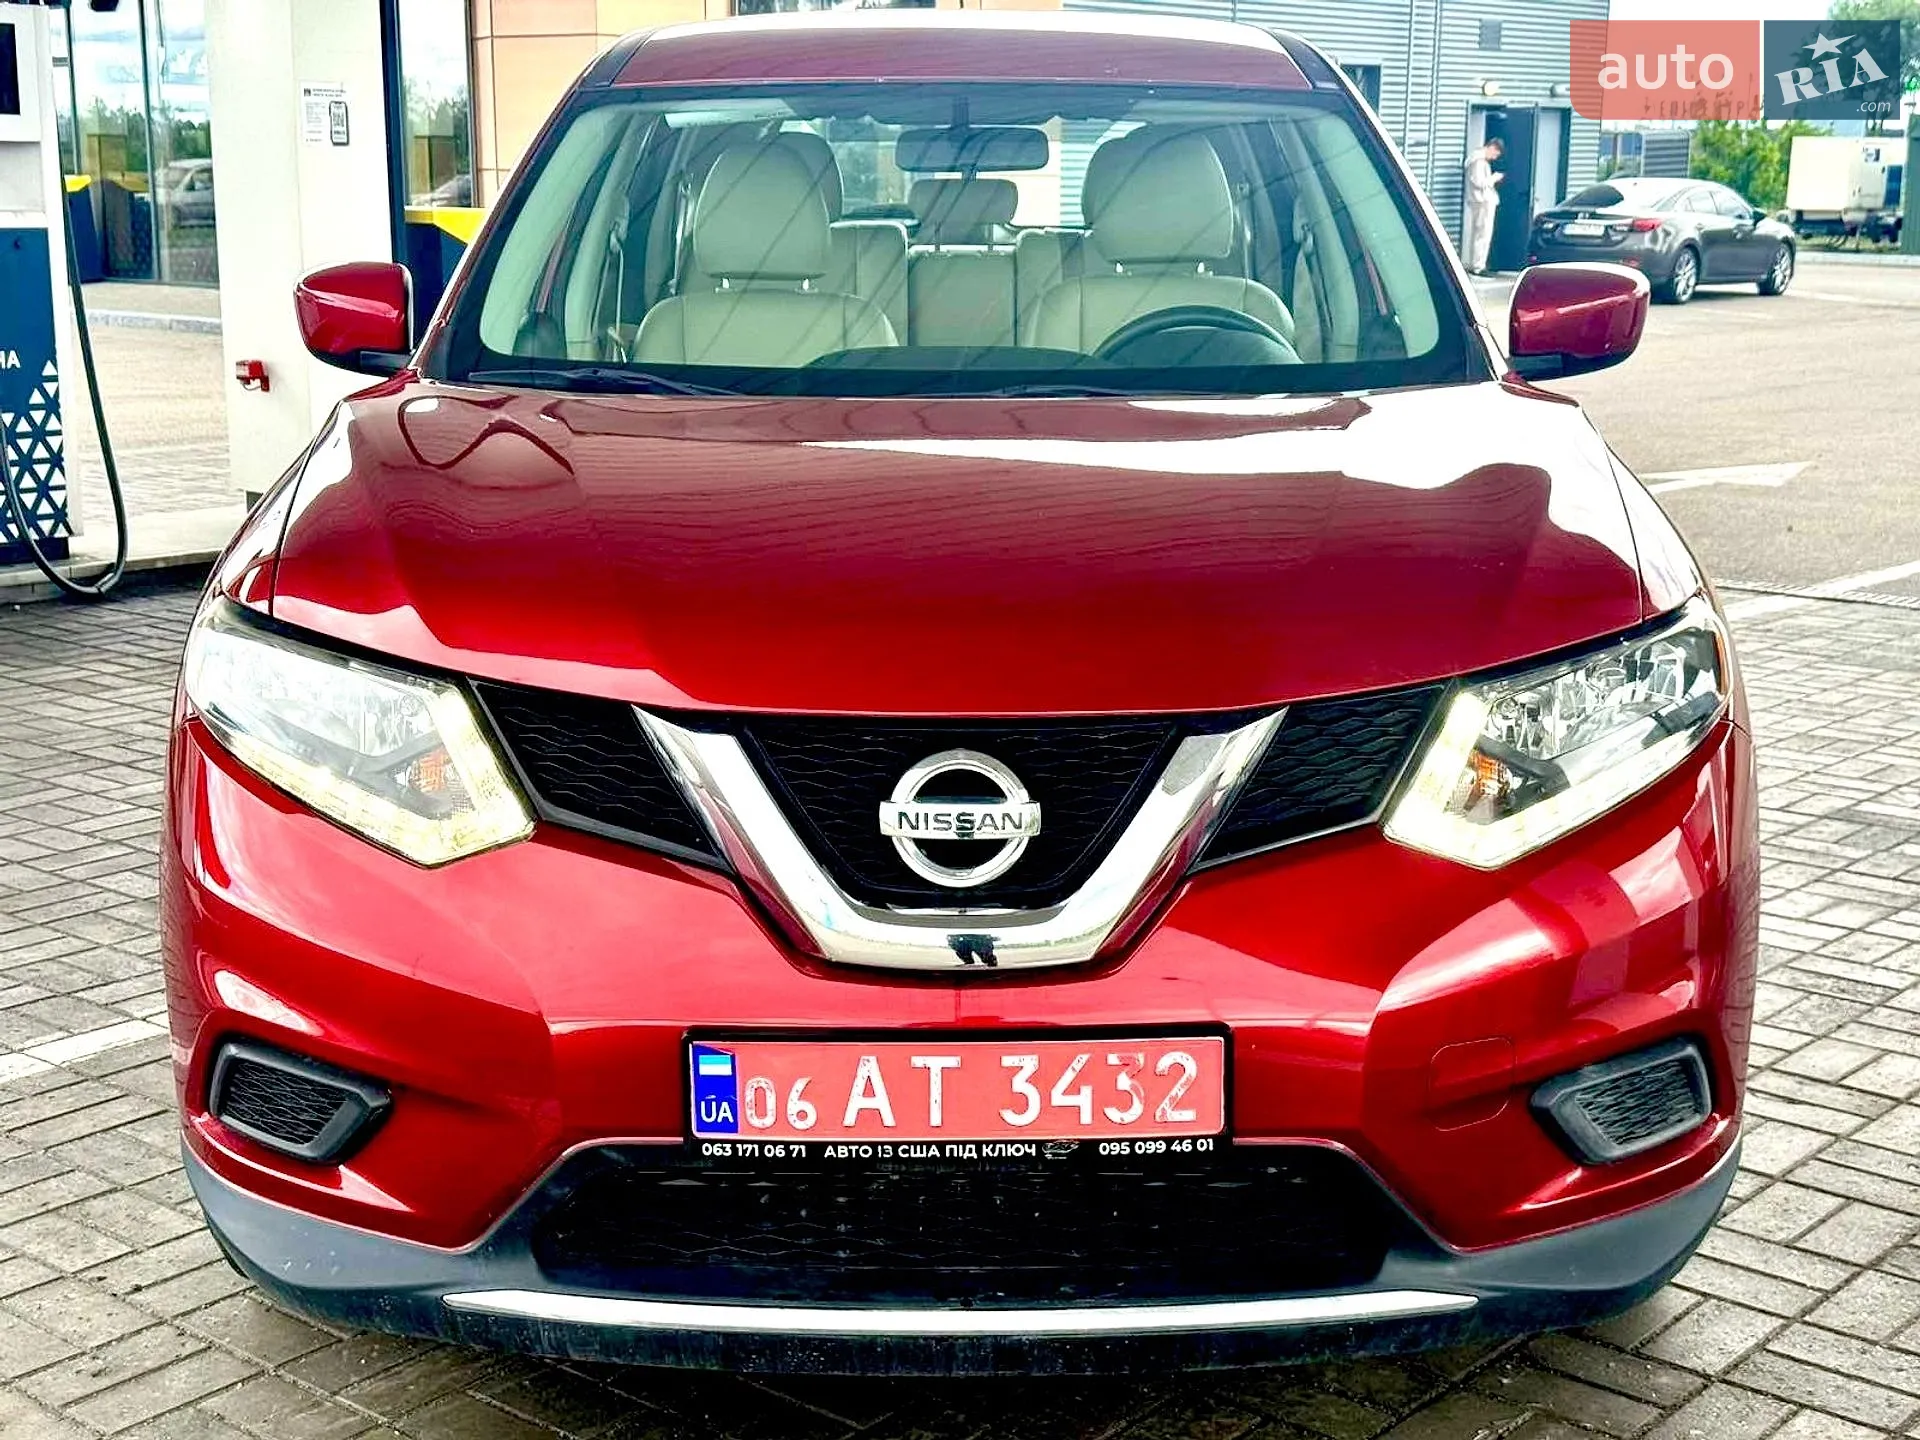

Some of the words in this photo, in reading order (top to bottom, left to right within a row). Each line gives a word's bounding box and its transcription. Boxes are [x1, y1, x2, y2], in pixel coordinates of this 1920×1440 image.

[897, 811, 1023, 832] NISSAN
[743, 1075, 818, 1130] 06
[998, 1051, 1198, 1127] 3432
[700, 1101, 734, 1123] UA
[701, 1142, 733, 1157] 063
[735, 1143, 759, 1158] 171
[763, 1144, 786, 1158] 06
[789, 1144, 806, 1158] 71
[823, 1144, 873, 1159] АВТО
[897, 1144, 941, 1158] США
[945, 1144, 978, 1160] ПІД
[982, 1143, 1036, 1158] КЛЮЧ
[1098, 1141, 1131, 1156] 095
[1134, 1140, 1167, 1155] 099
[1170, 1139, 1193, 1153] 46
[1196, 1138, 1214, 1152] 01
